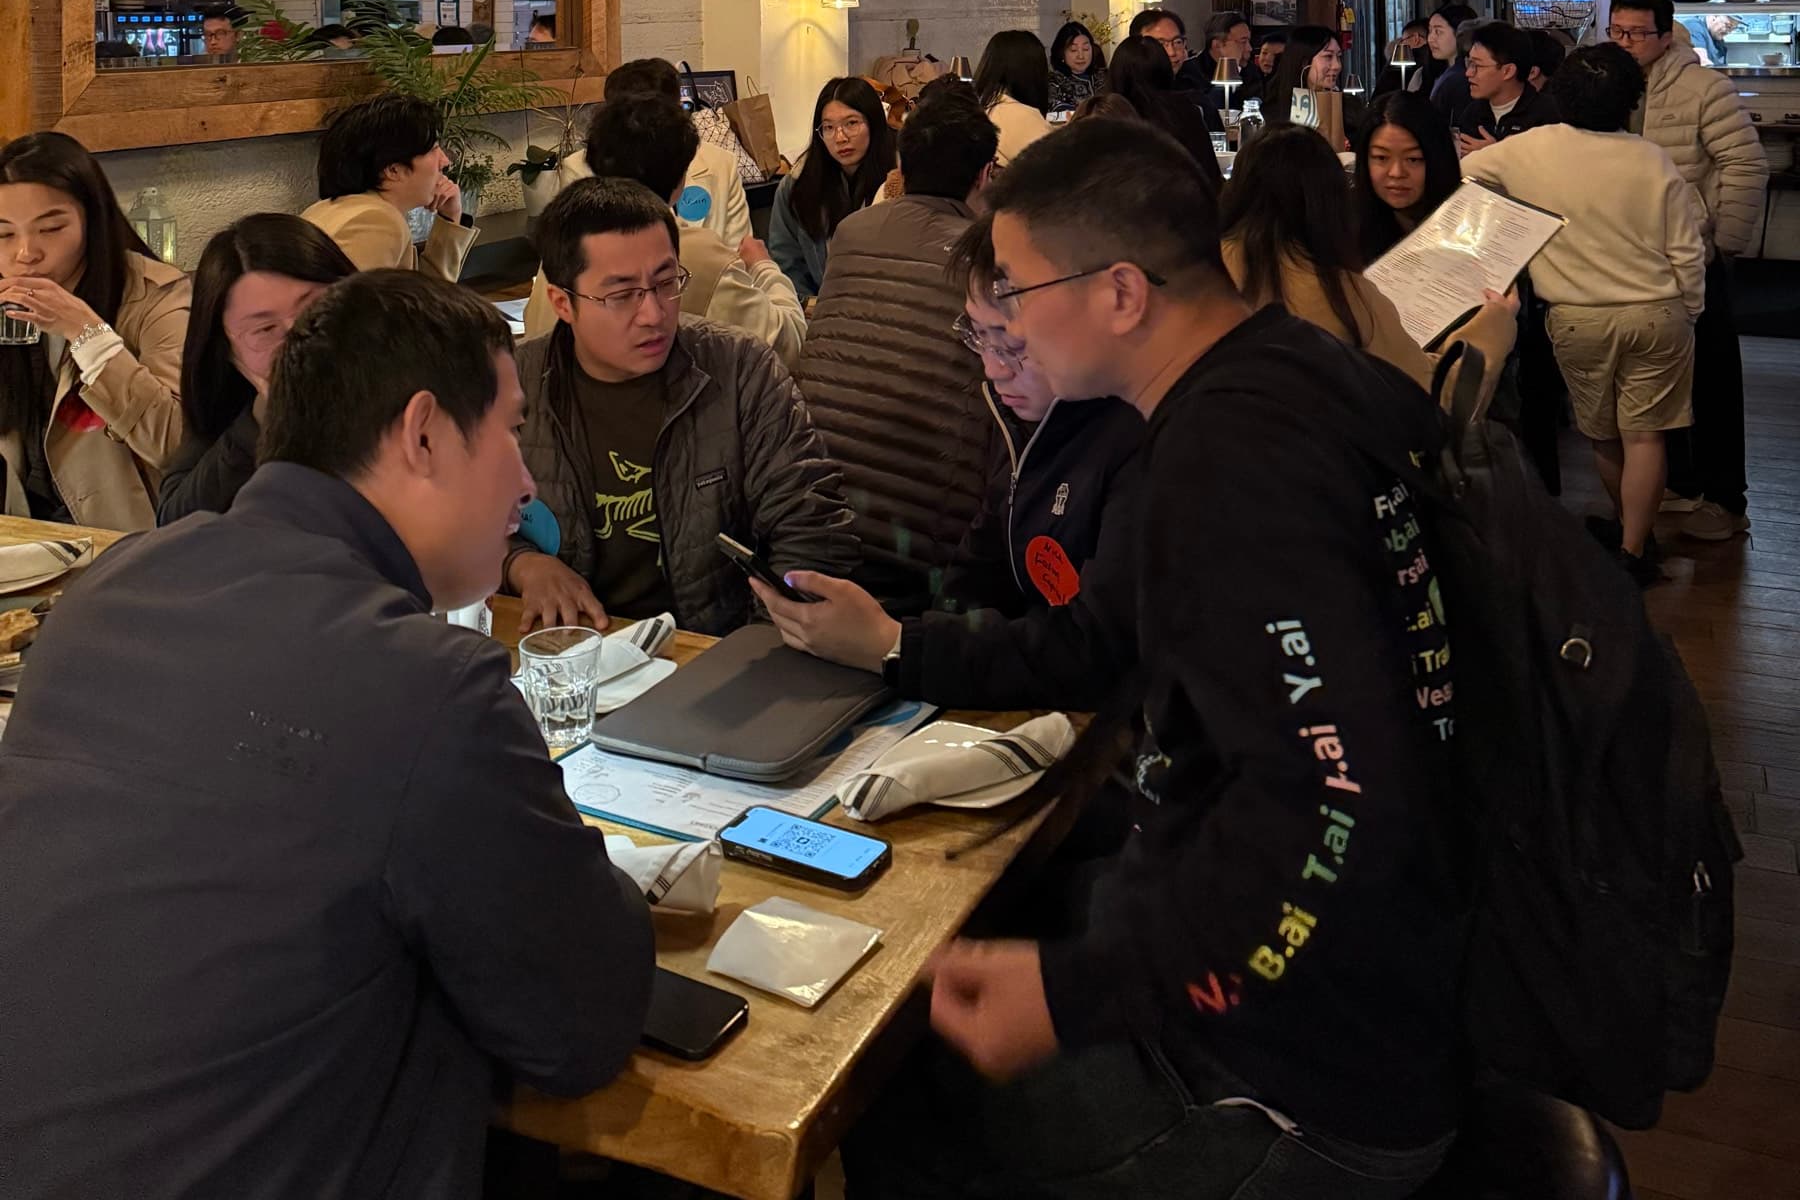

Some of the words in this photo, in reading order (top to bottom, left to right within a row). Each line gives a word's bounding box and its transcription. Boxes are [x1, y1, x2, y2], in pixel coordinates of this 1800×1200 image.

[1265, 619, 1323, 705] Y.ai
[1303, 804, 1356, 884] T.ai
[1247, 901, 1318, 981] B.ai
